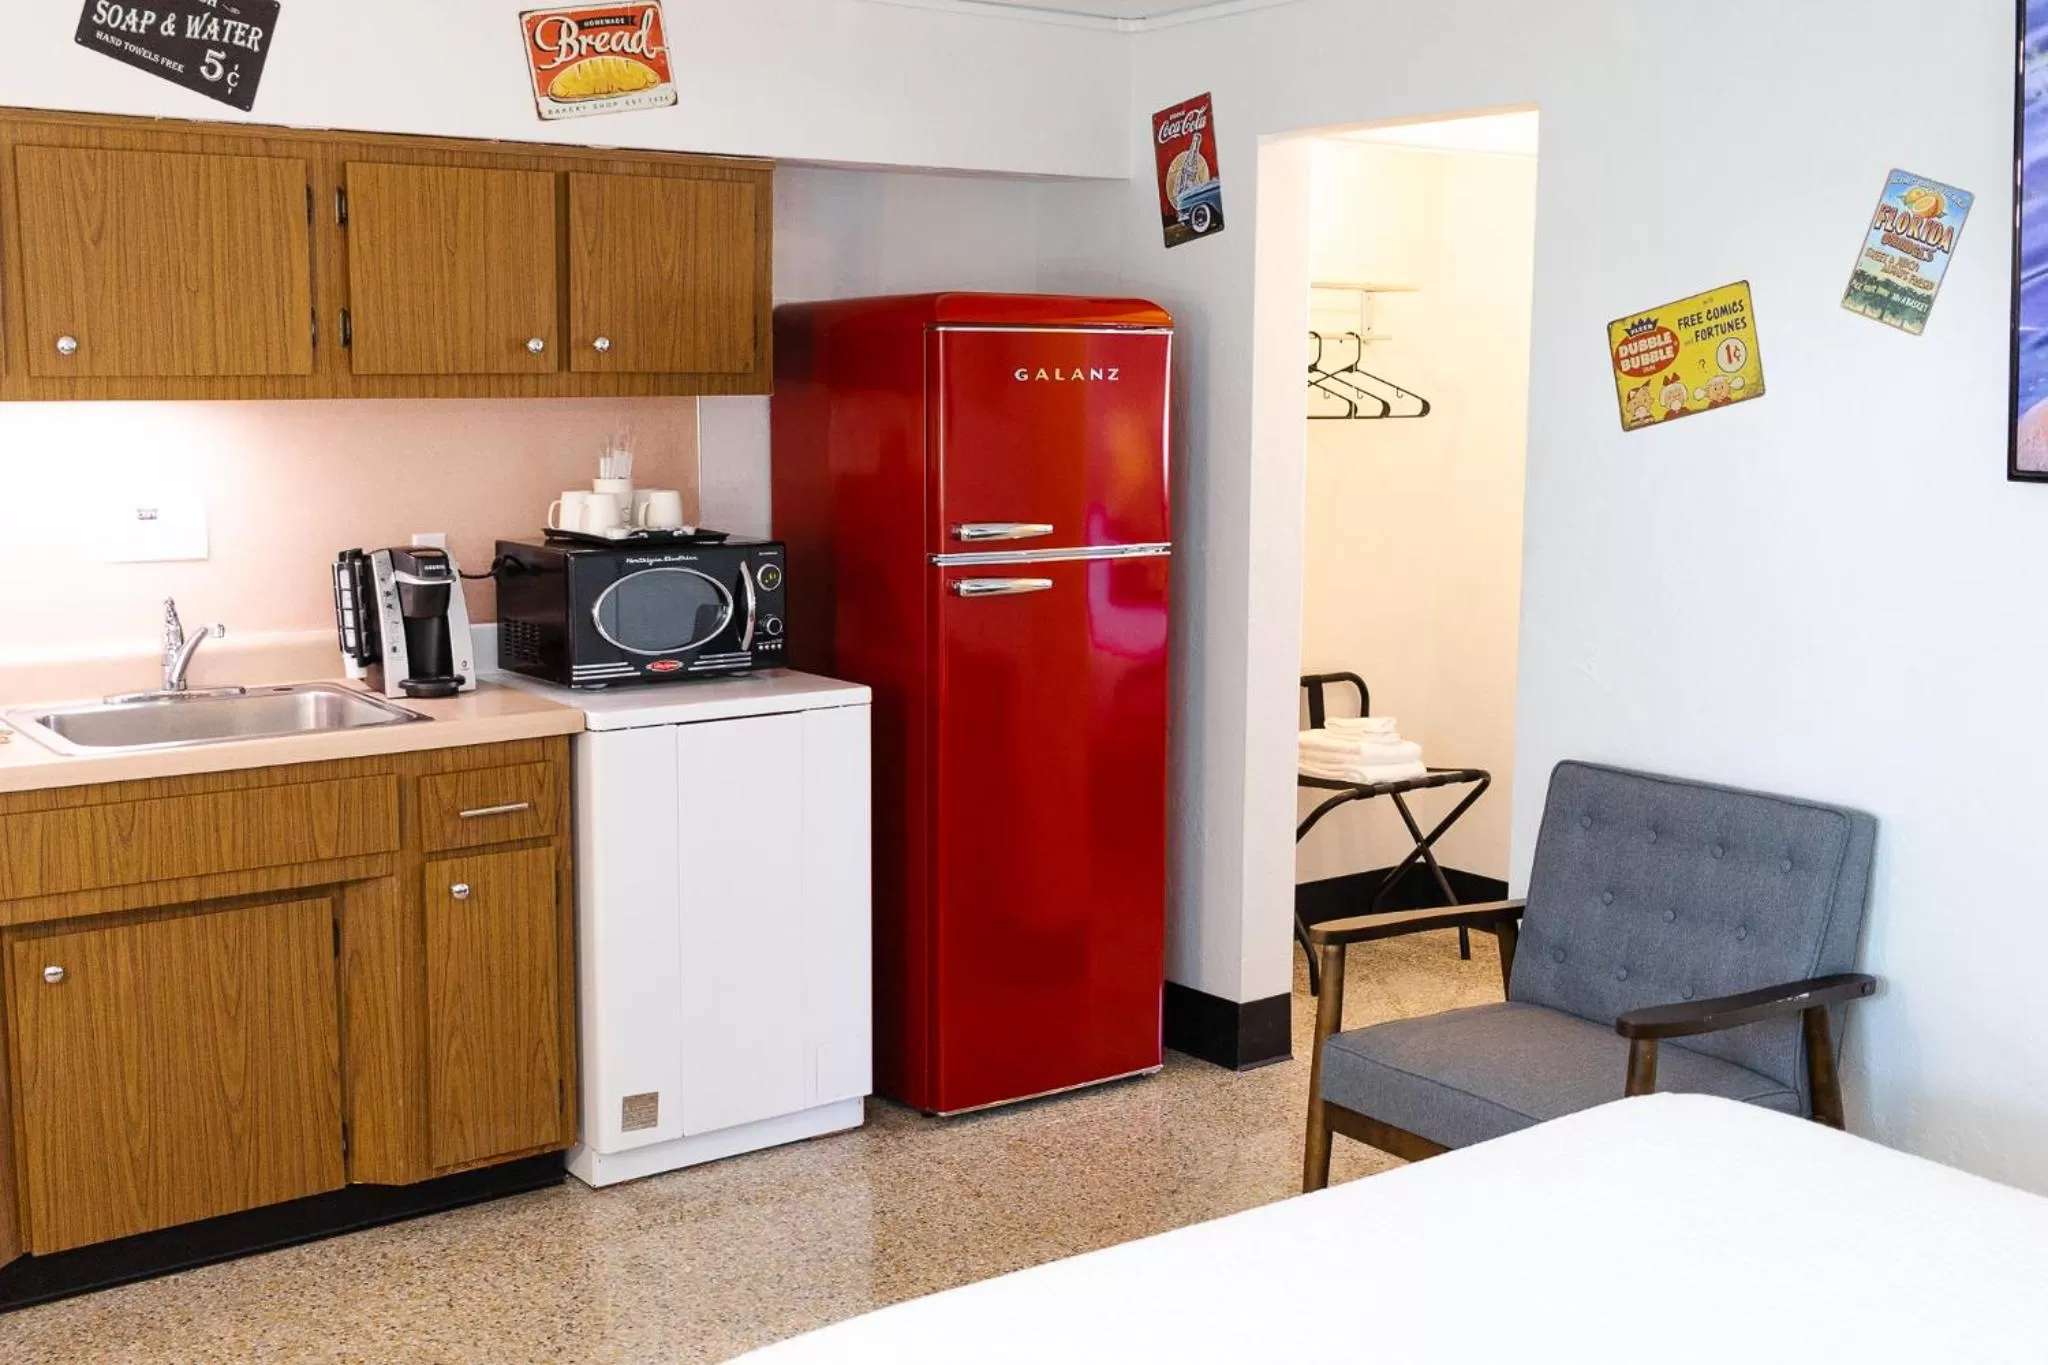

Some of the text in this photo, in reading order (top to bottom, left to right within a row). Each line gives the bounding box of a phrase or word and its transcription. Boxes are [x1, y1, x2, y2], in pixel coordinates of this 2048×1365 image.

[92, 1, 263, 53] SOAP & WATER
[583, 17, 626, 28] HOMEMADE
[95, 30, 185, 73] HAND TOWELS FREE
[534, 7, 667, 70] Bread
[1873, 203, 1954, 254] FLORIDA
[1677, 299, 1745, 331] FREE COMICS
[1695, 316, 1747, 343] FORTUNES
[1618, 331, 1672, 358] DUBBLE
[1620, 346, 1675, 373] BUBBLE
[1014, 367, 1121, 382] GALANZ
